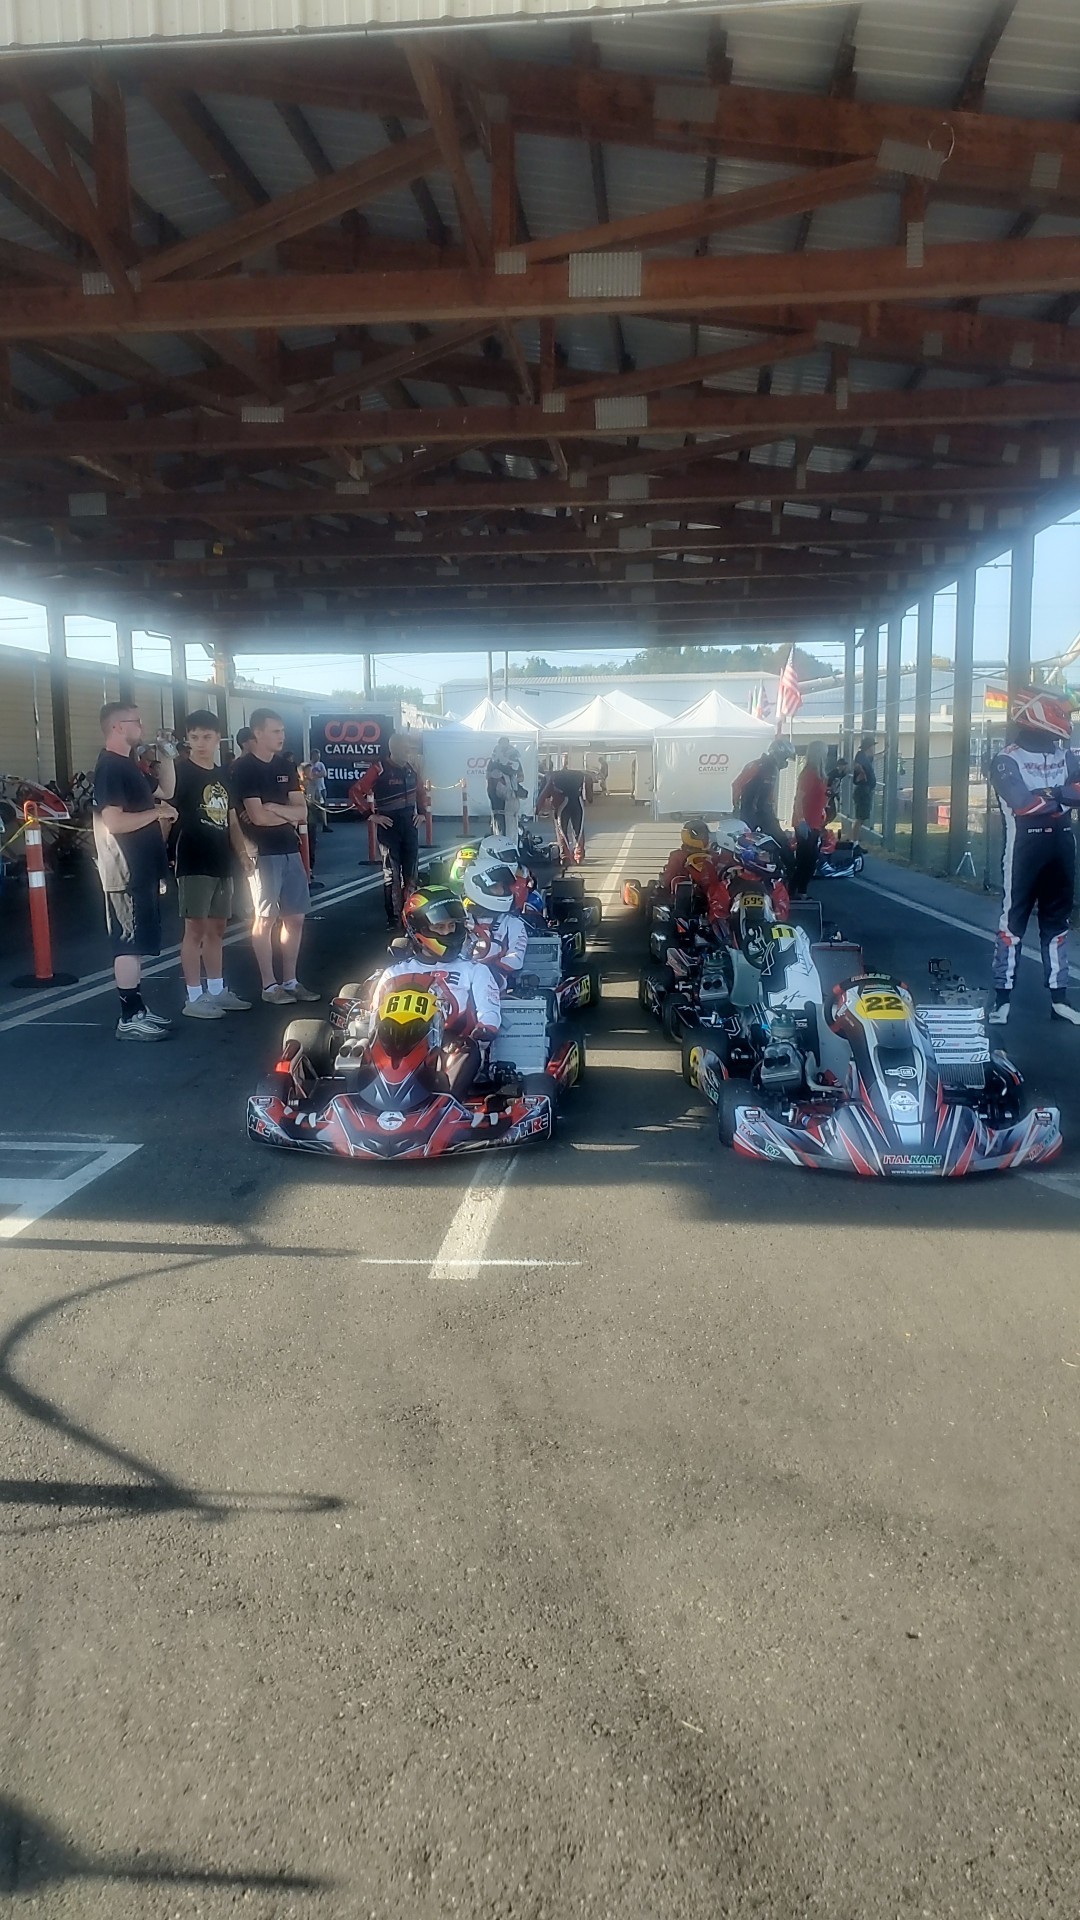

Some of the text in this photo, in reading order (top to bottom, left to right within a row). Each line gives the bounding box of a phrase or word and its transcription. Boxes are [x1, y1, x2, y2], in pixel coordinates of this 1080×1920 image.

[325, 744, 381, 754] CATALYST
[743, 897, 764, 906] 695
[775, 928, 795, 938] 11
[386, 994, 429, 1016] 619
[865, 996, 904, 1012] 22
[517, 1113, 549, 1139] HRE
[883, 1155, 943, 1165] ITALKART
